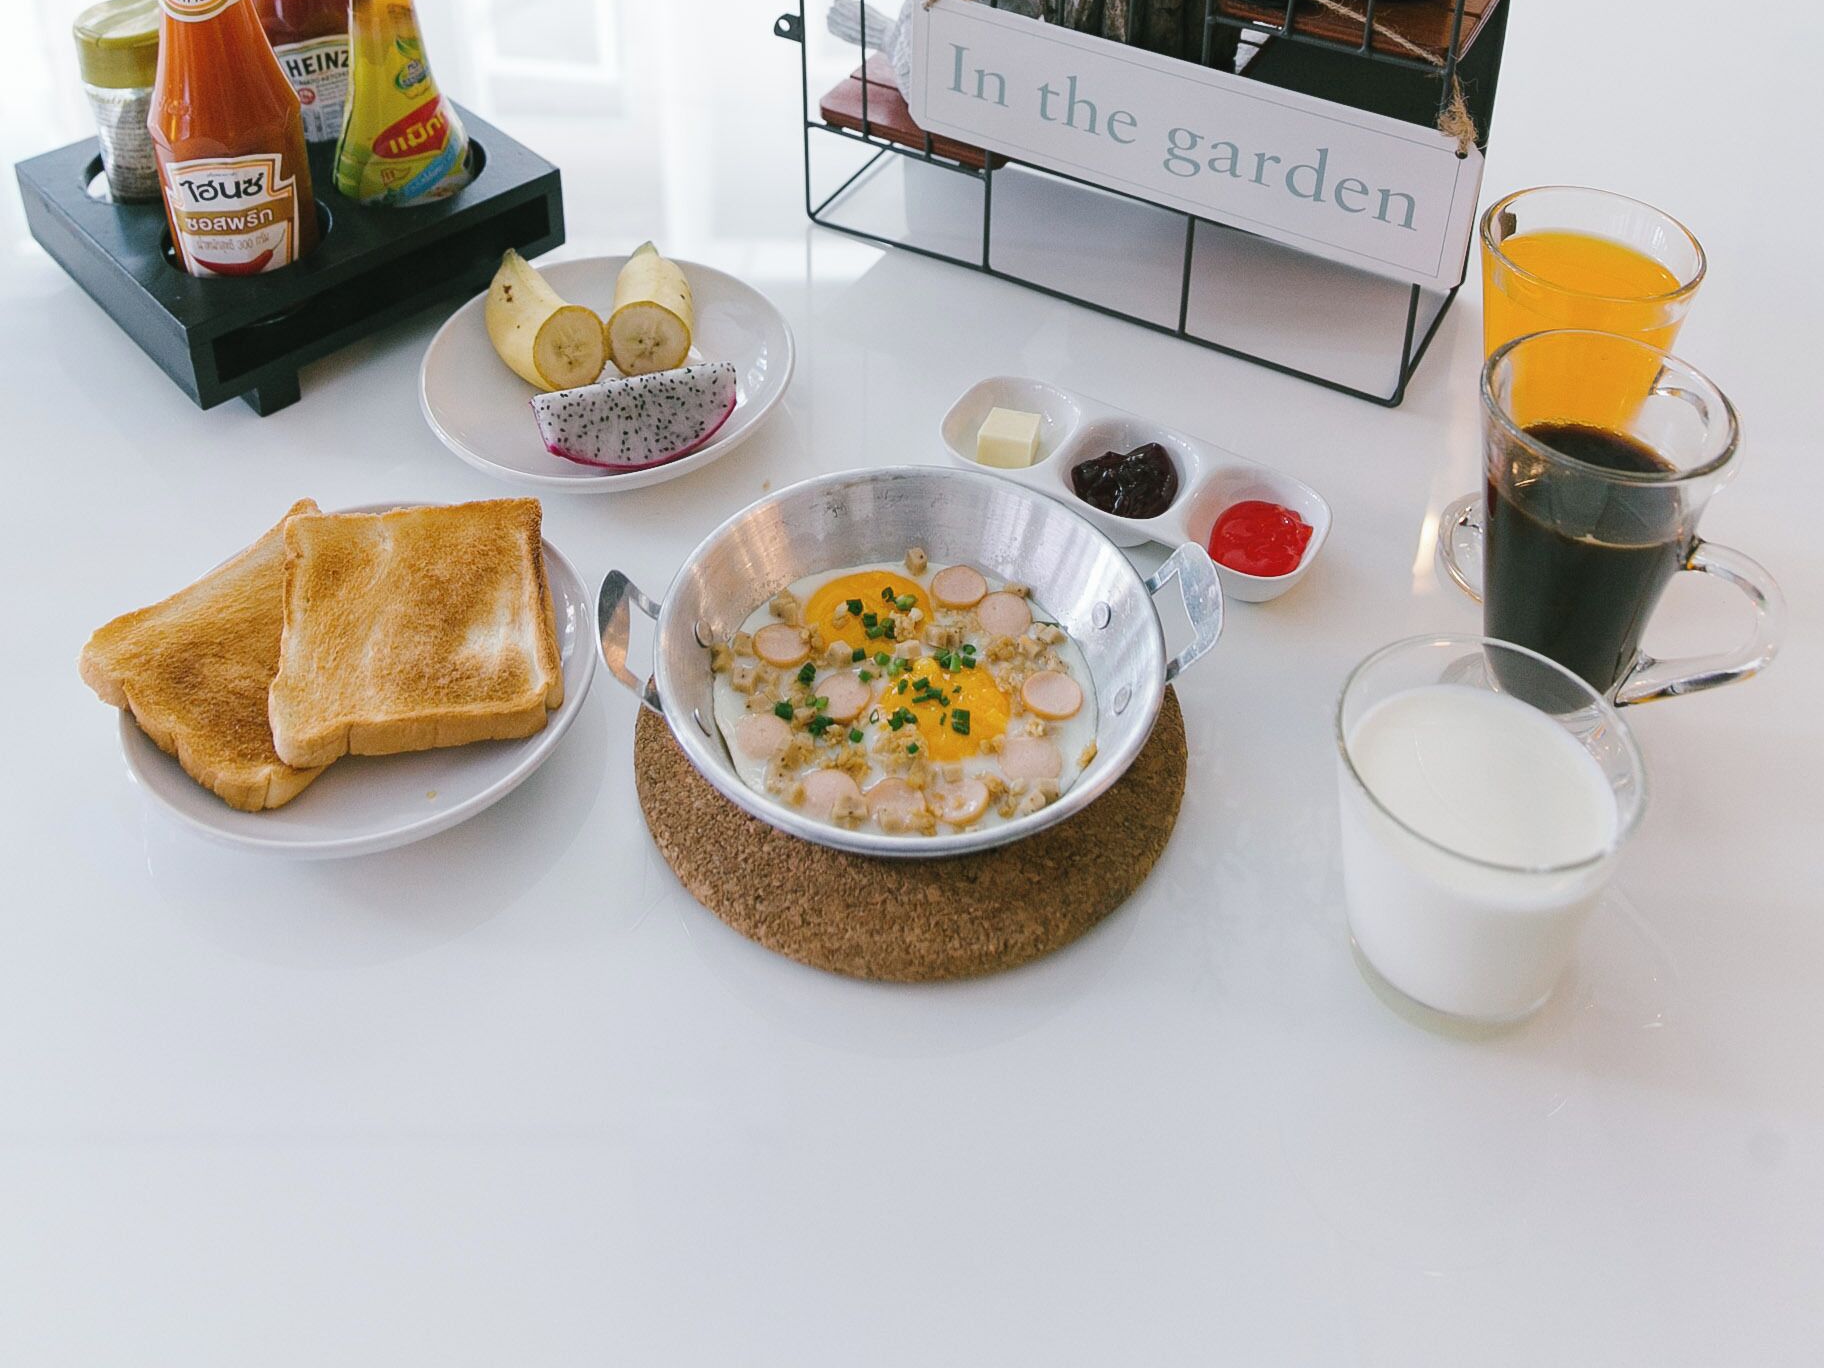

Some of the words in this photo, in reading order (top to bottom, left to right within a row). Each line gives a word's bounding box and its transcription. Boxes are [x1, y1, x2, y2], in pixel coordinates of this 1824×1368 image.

[285, 50, 349, 78] HEINZ
[946, 42, 1010, 108] In
[1037, 74, 1139, 145] the
[1162, 126, 1418, 232] garden
[184, 208, 273, 232] ซอสพริก
